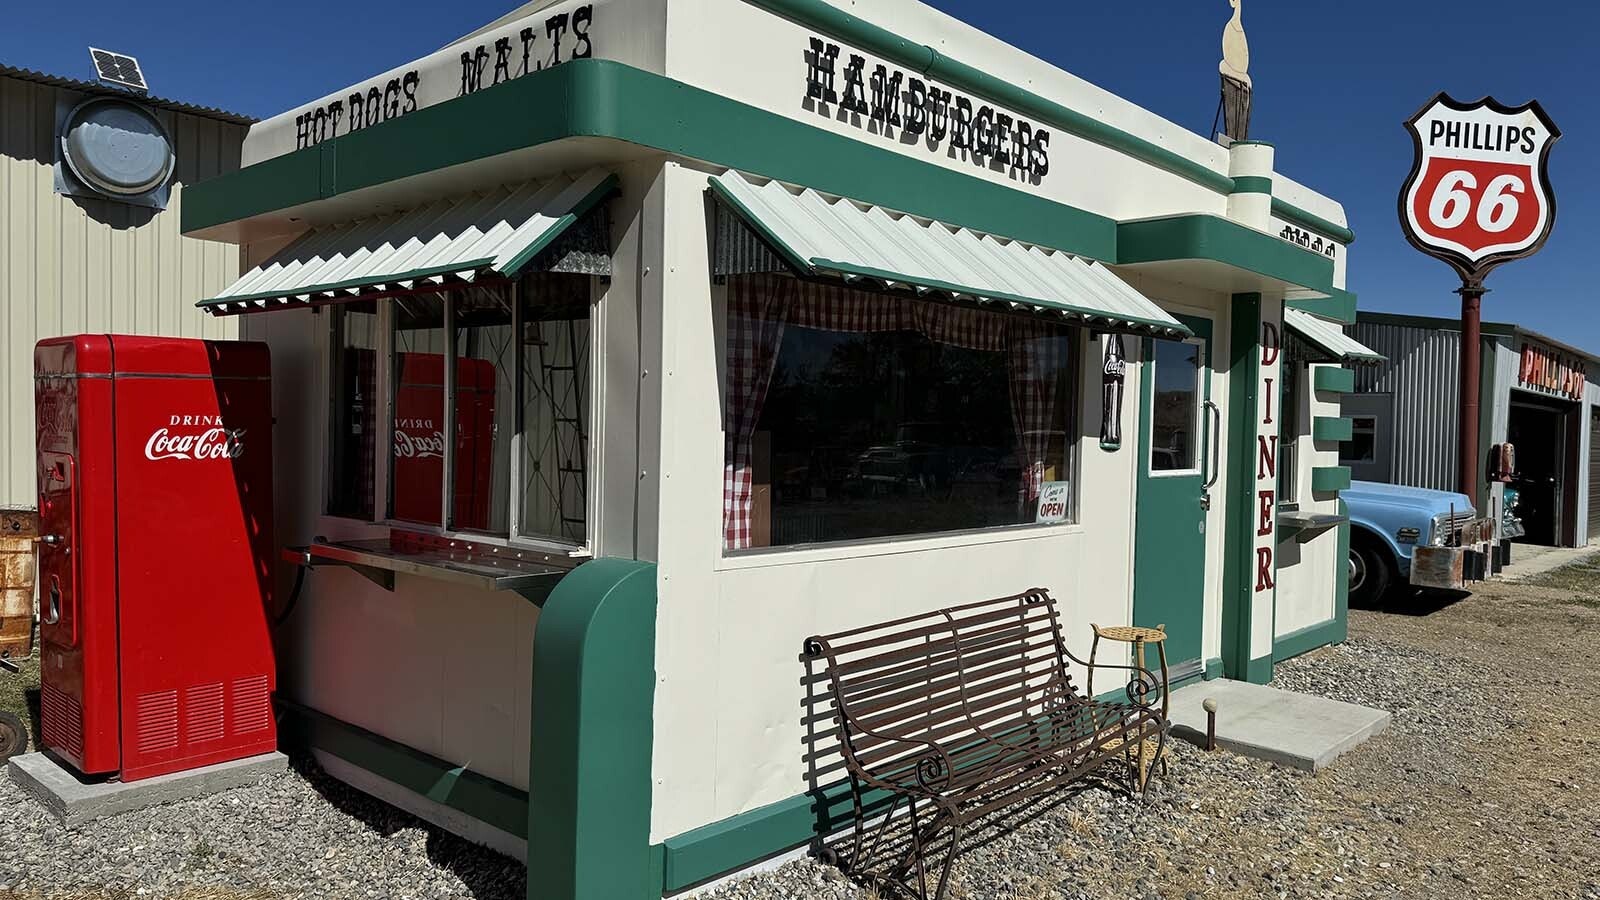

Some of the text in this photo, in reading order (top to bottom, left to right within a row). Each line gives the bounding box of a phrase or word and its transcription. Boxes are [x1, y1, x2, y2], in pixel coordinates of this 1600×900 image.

[296, 4, 593, 151] HOT DOGS MALTS
[806, 36, 1050, 177] HAMBURGERS
[1429, 119, 1536, 154] PHILLIPS
[1428, 169, 1526, 233] 66
[144, 427, 247, 461] Coca-Cola
[169, 415, 224, 426] DRINK
[1255, 321, 1280, 593] DINER
[1040, 502, 1064, 517] OPEN
